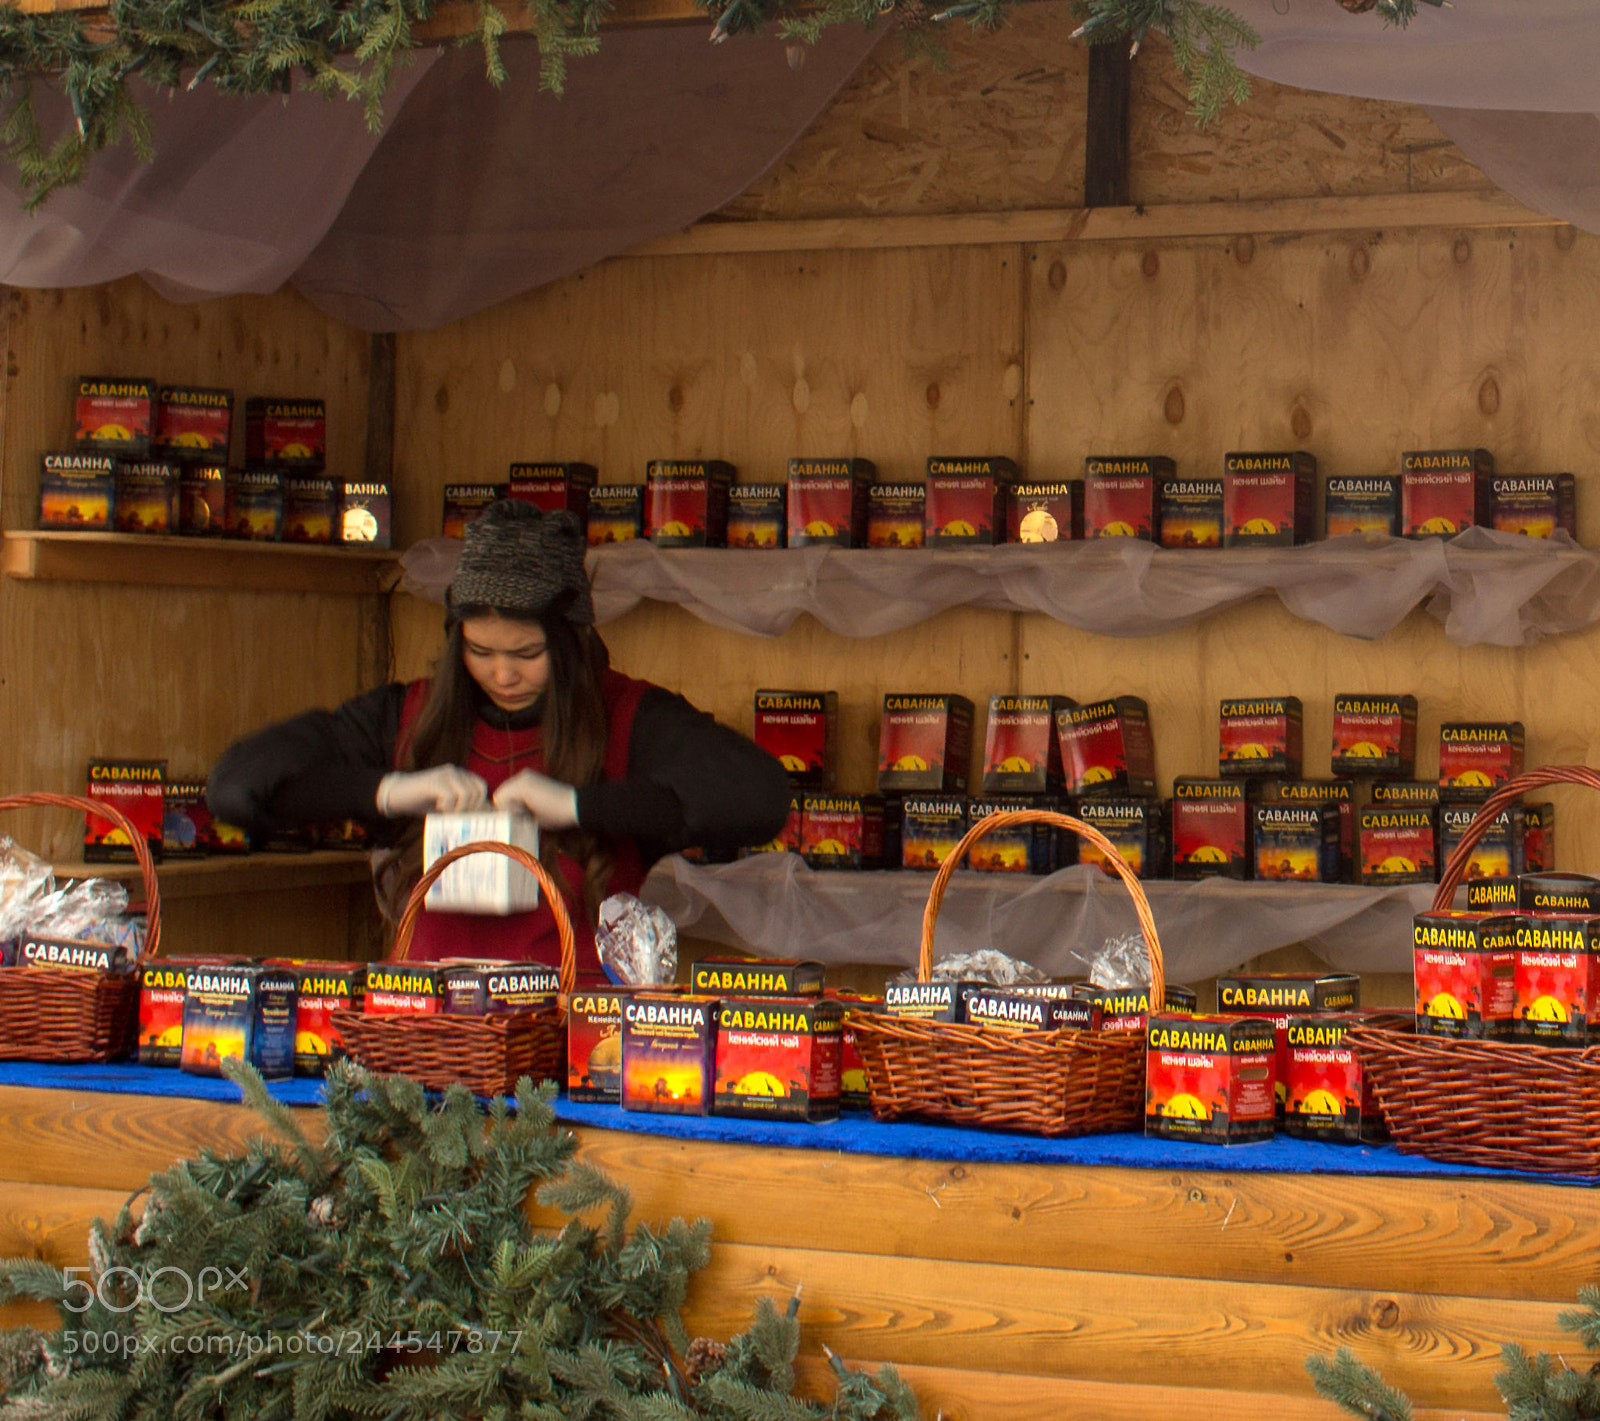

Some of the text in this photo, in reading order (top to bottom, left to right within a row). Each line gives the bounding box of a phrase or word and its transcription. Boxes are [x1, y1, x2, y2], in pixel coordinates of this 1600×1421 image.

[80, 383, 149, 398] САВАННА
[162, 392, 228, 407] САВАННА
[267, 405, 324, 417] САВАННА
[45, 455, 112, 470] САВАННА
[930, 462, 991, 473] САВАННА
[1088, 461, 1149, 474] САВАННА
[1228, 458, 1291, 471] САВАННА
[1405, 455, 1470, 469] САВАННА
[124, 464, 170, 477] ВАННА
[511, 466, 565, 478] САВАННА
[649, 465, 705, 476] САВАННА
[790, 464, 849, 475] САВАННА
[240, 472, 280, 485] АННА
[290, 479, 334, 491] ВАННА
[1493, 479, 1554, 491] САВАННА
[345, 482, 388, 496] ВАННА
[446, 487, 495, 498] САВАННА
[589, 487, 639, 498] САВАННА
[729, 487, 781, 498] САВАННА
[870, 486, 925, 498] САВАННА
[1011, 484, 1068, 496] САВАННА
[1163, 483, 1223, 495] САВАННА
[1329, 480, 1392, 492] САВАННА
[757, 696, 821, 710] САВАННА
[886, 698, 945, 710] САВАННА
[991, 699, 1049, 711] САВАННА
[1336, 701, 1399, 714] САВАННА
[1058, 703, 1116, 726] САВАННА
[1222, 703, 1284, 717] САВАННА
[1442, 729, 1508, 742] САВАННА
[91, 766, 162, 781] САВАННА
[1177, 785, 1241, 798] САВАННА
[1281, 786, 1349, 798] САВАННА
[1374, 787, 1438, 800] САВАННА
[804, 799, 861, 812] САВАННА
[904, 801, 962, 815] САВАННА
[1081, 805, 1144, 819] САВАННА
[1258, 809, 1318, 822] САВАННА
[1362, 813, 1430, 828] САВАННА
[1469, 885, 1516, 904] САВАННА
[1535, 895, 1590, 908] САВАННА
[1415, 927, 1477, 949] САВАННА
[1483, 935, 1515, 949] САВА
[1517, 929, 1585, 950] САВАННА
[25, 943, 109, 968] САВАННА
[1562, 955, 1577, 968] чай
[144, 971, 185, 988] САВА
[187, 974, 251, 994] САВАННА
[260, 980, 295, 992] САВАННА
[367, 973, 433, 994] САВАННА
[448, 980, 480, 990] САВАННА
[488, 974, 560, 993] САВАННА
[697, 971, 788, 992] САВАННА
[301, 978, 348, 996] АННА
[886, 986, 951, 1004] САВАННА
[1222, 988, 1310, 1006] САВАННА
[572, 997, 621, 1014] САВА
[969, 997, 1042, 1023] САВАННА
[1166, 1003, 1193, 1014] ВАННА
[626, 1004, 705, 1026] САВАННА
[720, 1010, 809, 1032] САВАННА
[1053, 1010, 1088, 1022] САВАННА
[780, 1036, 799, 1049] чай
[1150, 1029, 1227, 1052] САВАННА
[1233, 1039, 1274, 1052] САВАННА
[1336, 1051, 1352, 1065] чай
